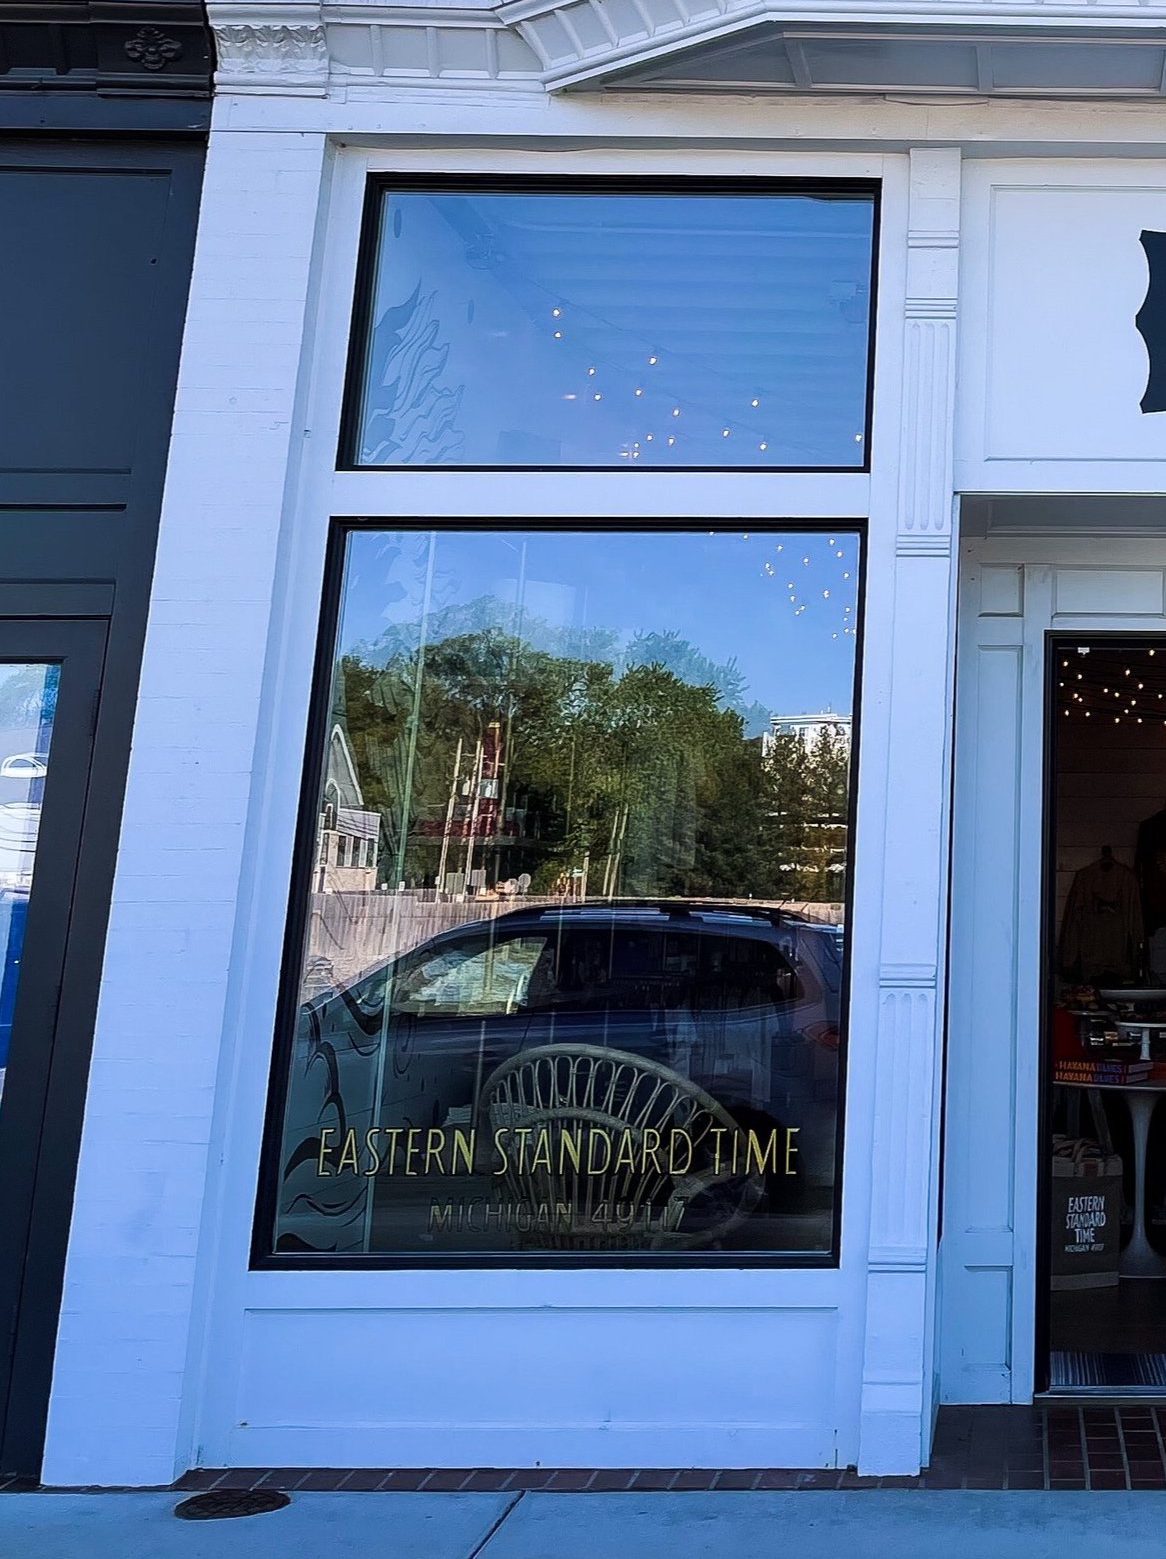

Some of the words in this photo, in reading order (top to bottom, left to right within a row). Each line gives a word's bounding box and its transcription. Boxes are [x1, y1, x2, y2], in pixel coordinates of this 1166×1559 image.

[316, 1127, 477, 1178] EASTERN
[493, 1127, 695, 1177] STANDARD
[710, 1126, 802, 1176] TIME
[1068, 1195, 1105, 1213] EASTERN
[427, 1195, 573, 1234] MICHIGAN
[1065, 1211, 1107, 1229] STANDARD
[1074, 1227, 1095, 1243] TIME
